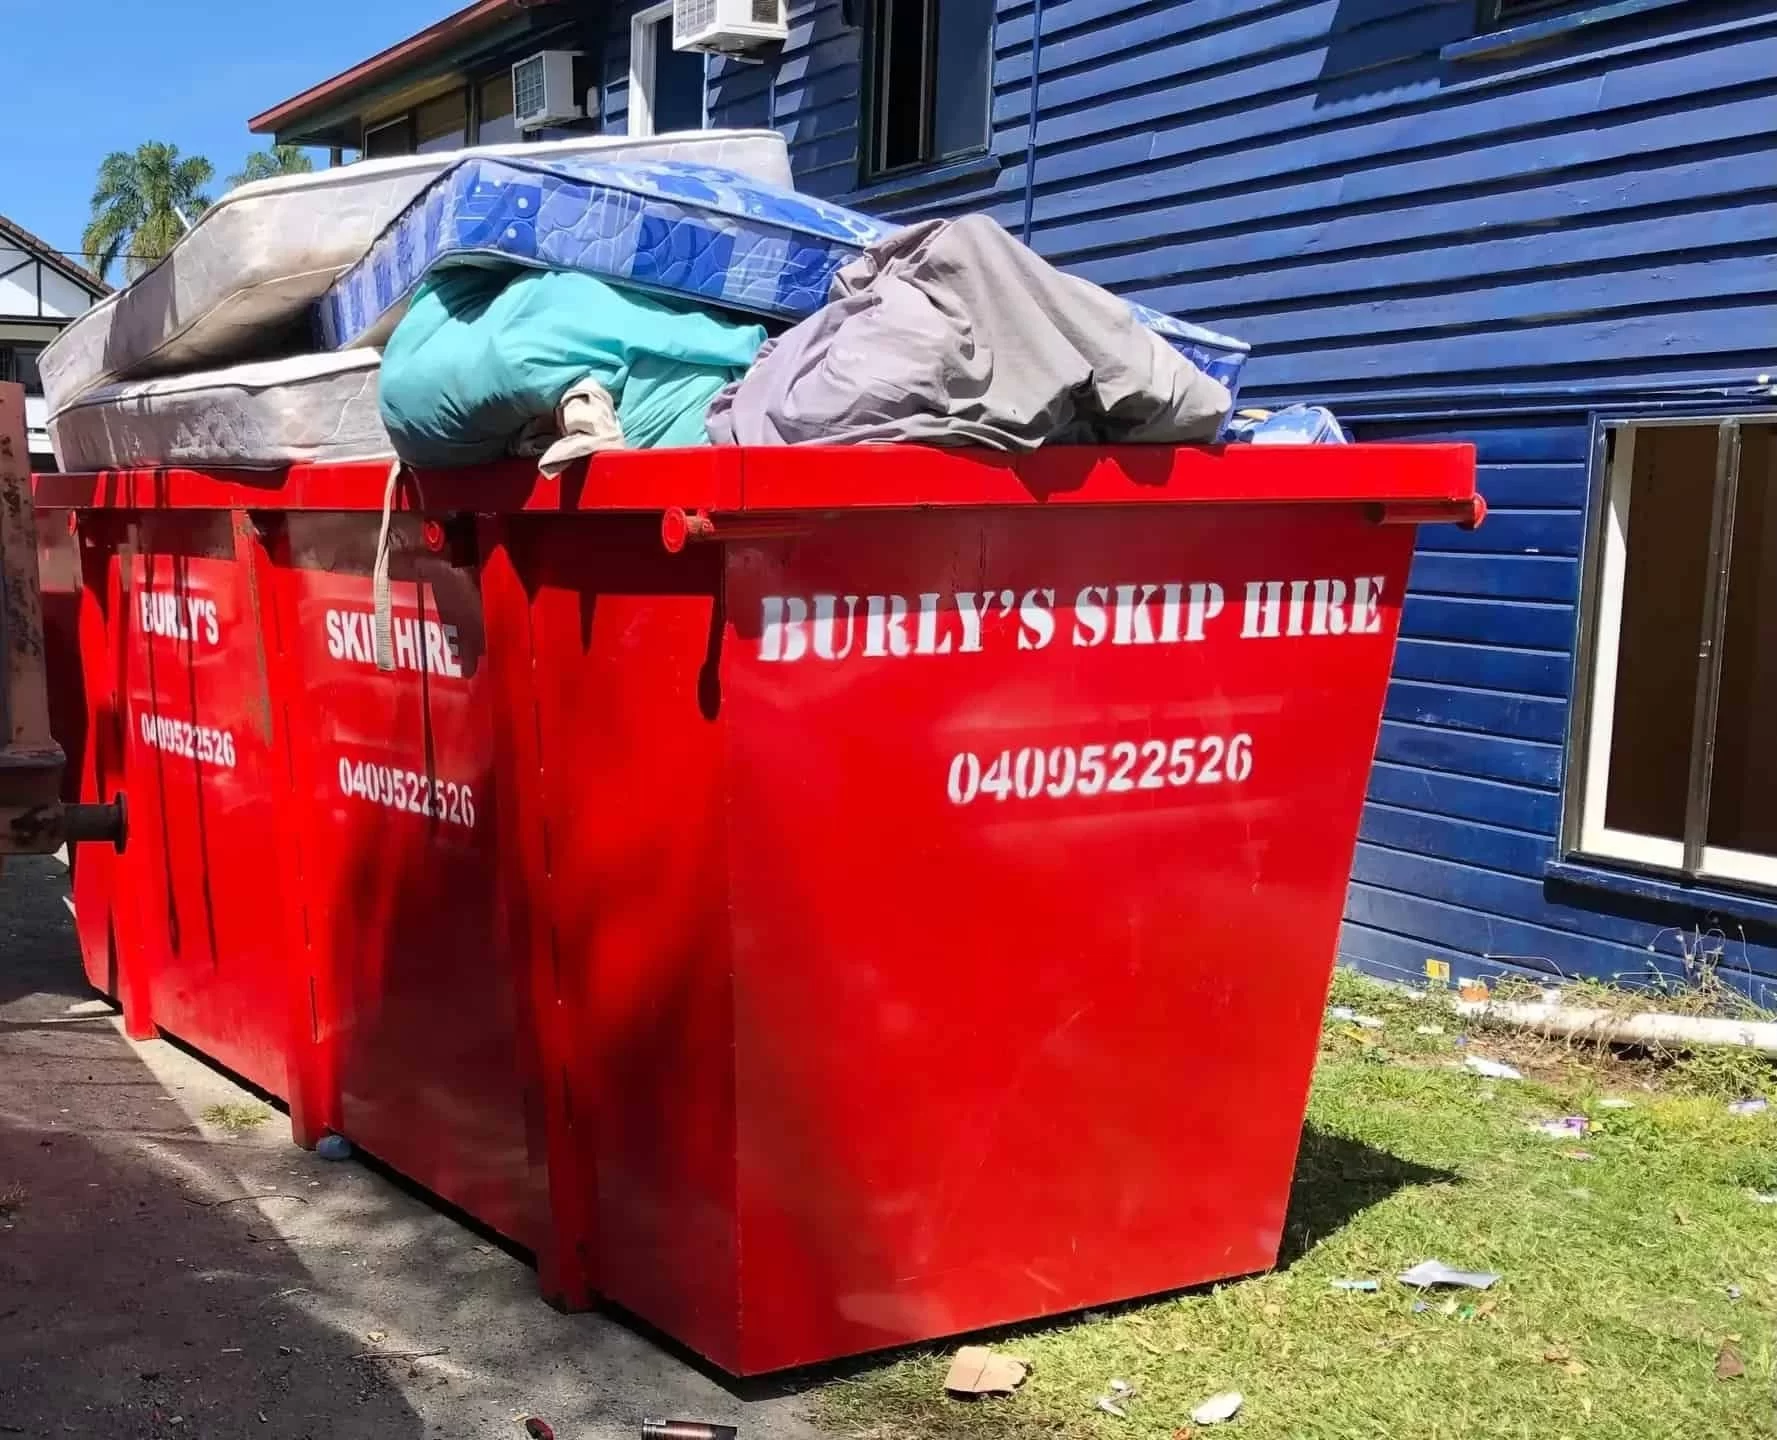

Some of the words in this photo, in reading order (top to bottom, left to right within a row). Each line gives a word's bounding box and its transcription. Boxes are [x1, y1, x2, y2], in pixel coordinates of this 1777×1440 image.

[141, 591, 219, 645] BURLY'S
[393, 617, 462, 678] HIRE
[757, 588, 1055, 661] BURLY'S
[1072, 582, 1224, 647] SKIP
[1240, 575, 1386, 639] HIRE
[141, 712, 236, 768] 0409522526
[947, 733, 1253, 804] 0409522526
[338, 757, 475, 828] 0409522526
